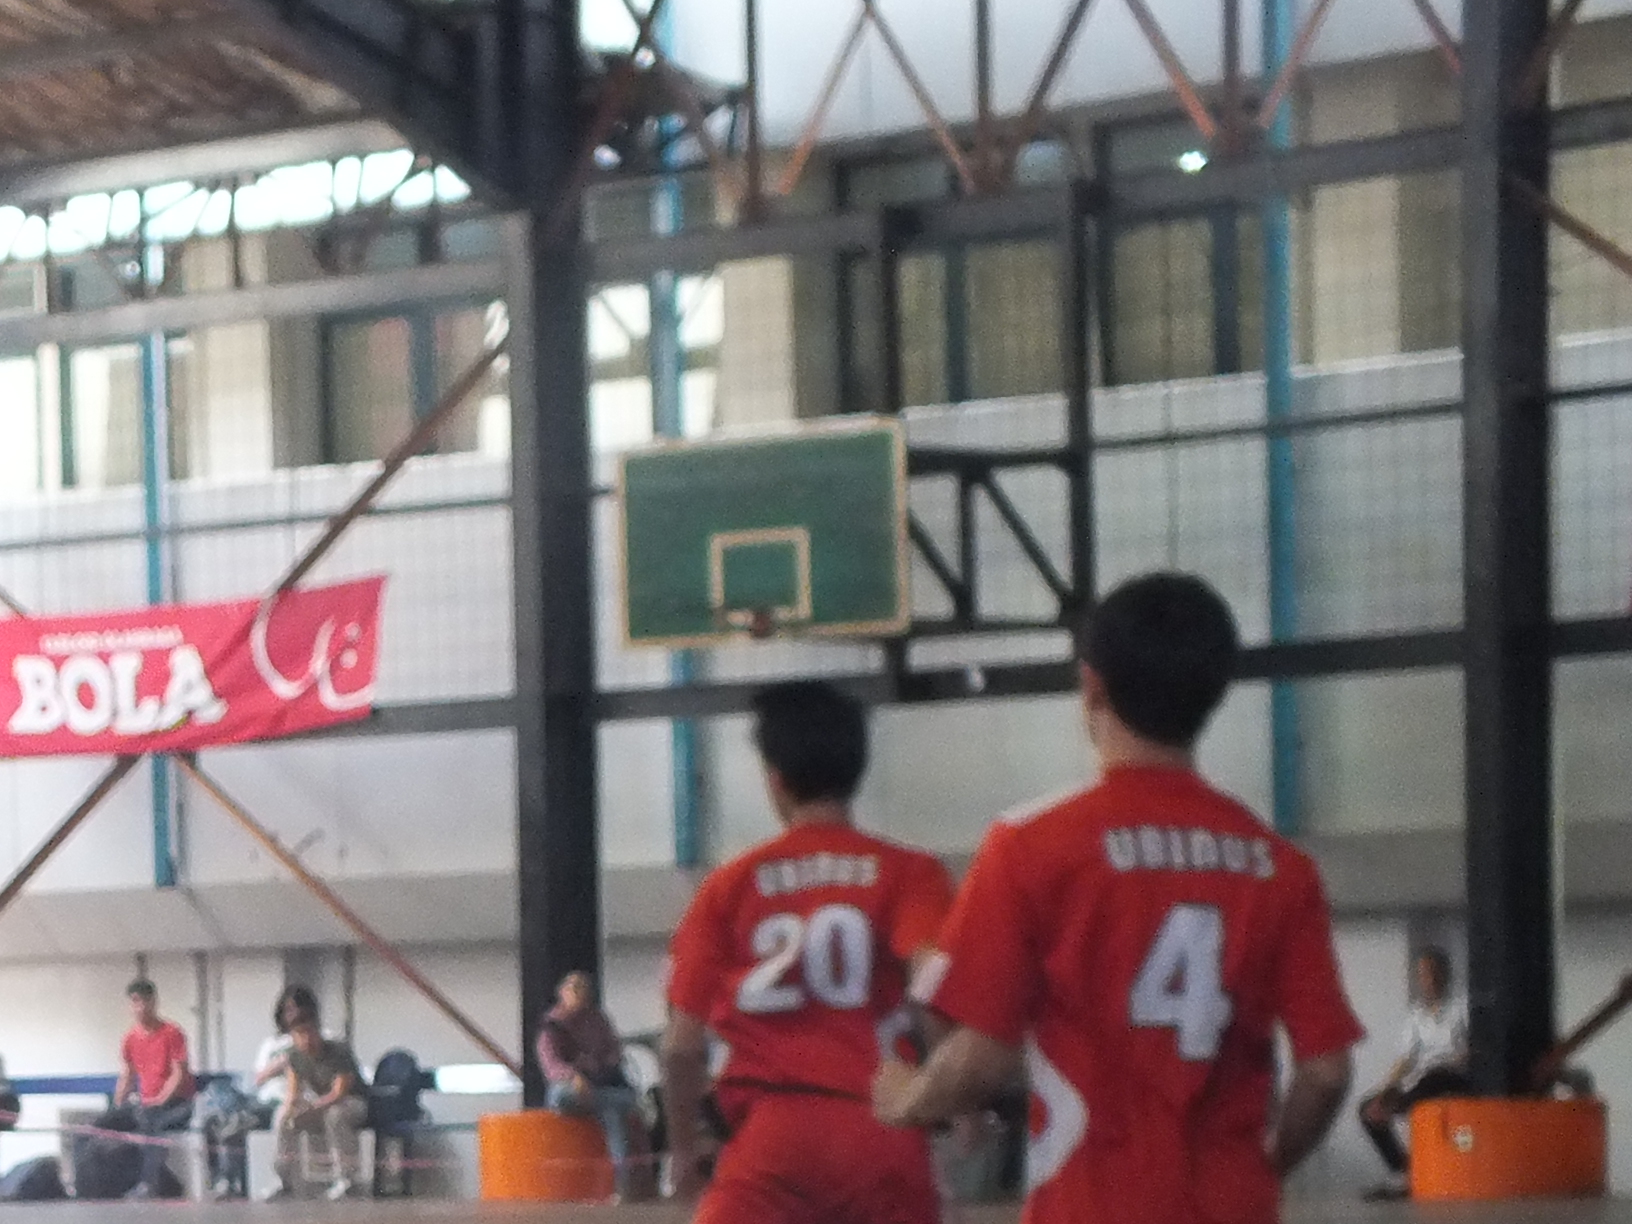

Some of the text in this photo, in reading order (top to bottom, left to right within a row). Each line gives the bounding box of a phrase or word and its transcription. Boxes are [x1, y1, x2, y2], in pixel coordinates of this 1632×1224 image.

[9, 646, 226, 734] BOLA
[737, 904, 871, 1014] 20
[1129, 903, 1230, 1061] 4
